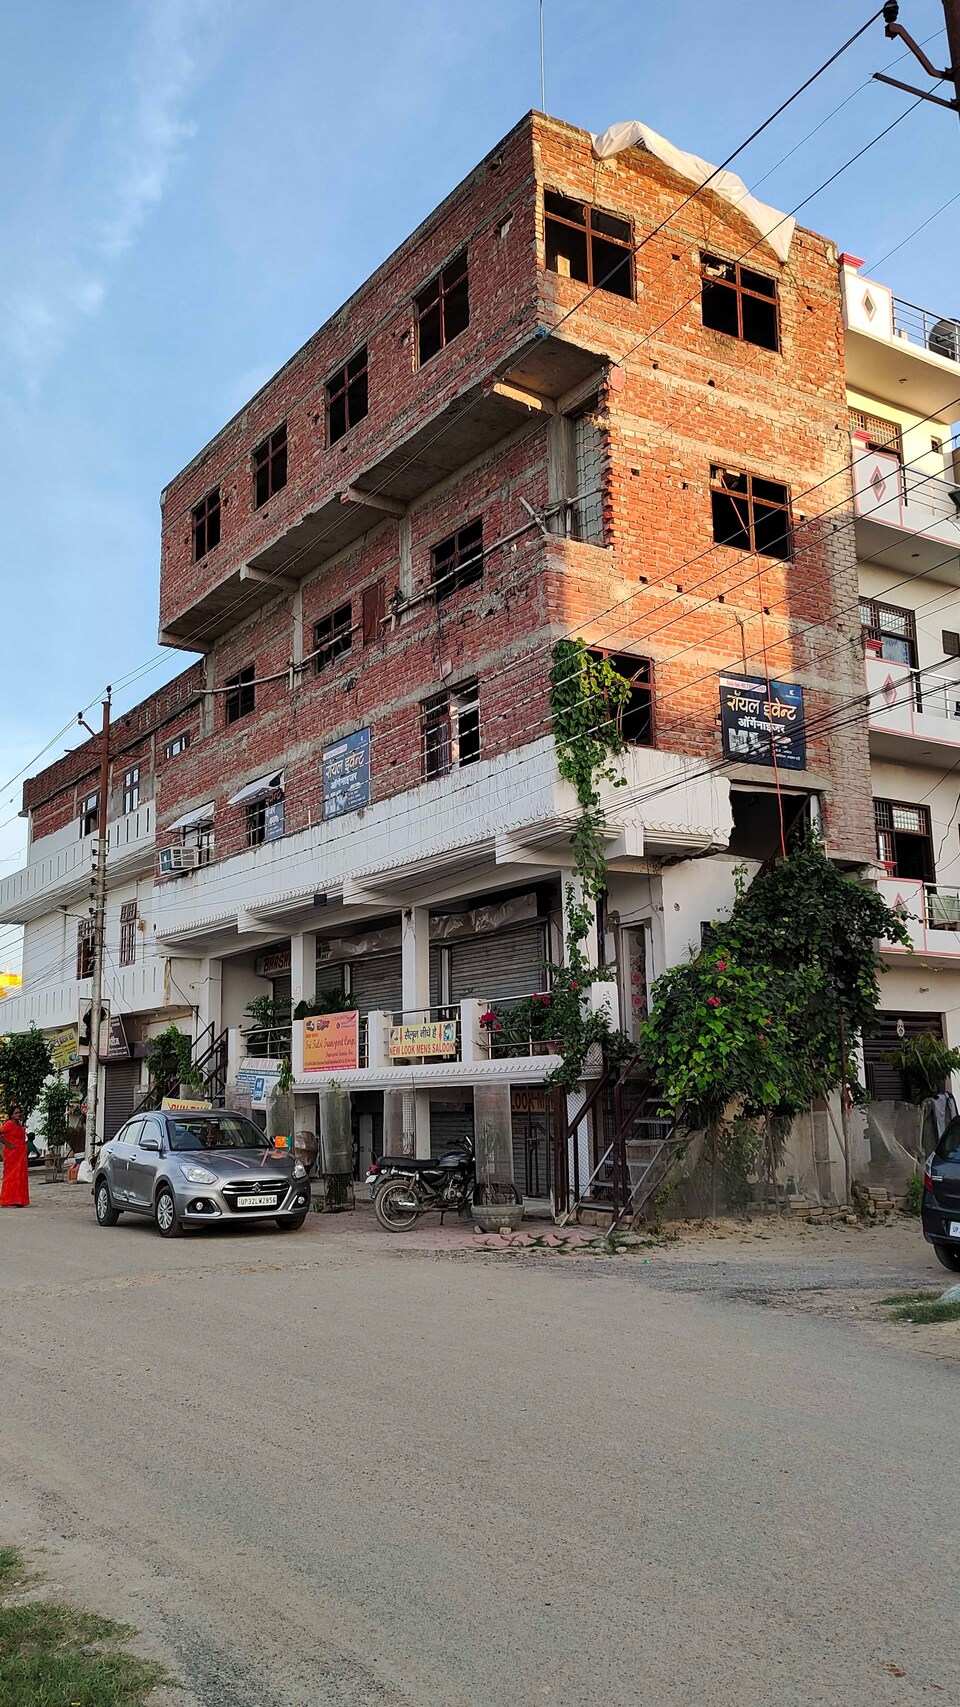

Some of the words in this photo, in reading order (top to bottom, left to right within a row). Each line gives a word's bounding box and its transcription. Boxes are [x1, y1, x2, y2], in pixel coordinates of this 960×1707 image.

[726, 690, 760, 714] रॉयल
[763, 697, 797, 720] इवेन्ट
[420, 1026, 431, 1039] नीचे
[390, 1046, 400, 1055] NEW
[402, 1045, 415, 1055] LOOK
[417, 1044, 430, 1054] MENS
[432, 1042, 456, 1053] SALOON
